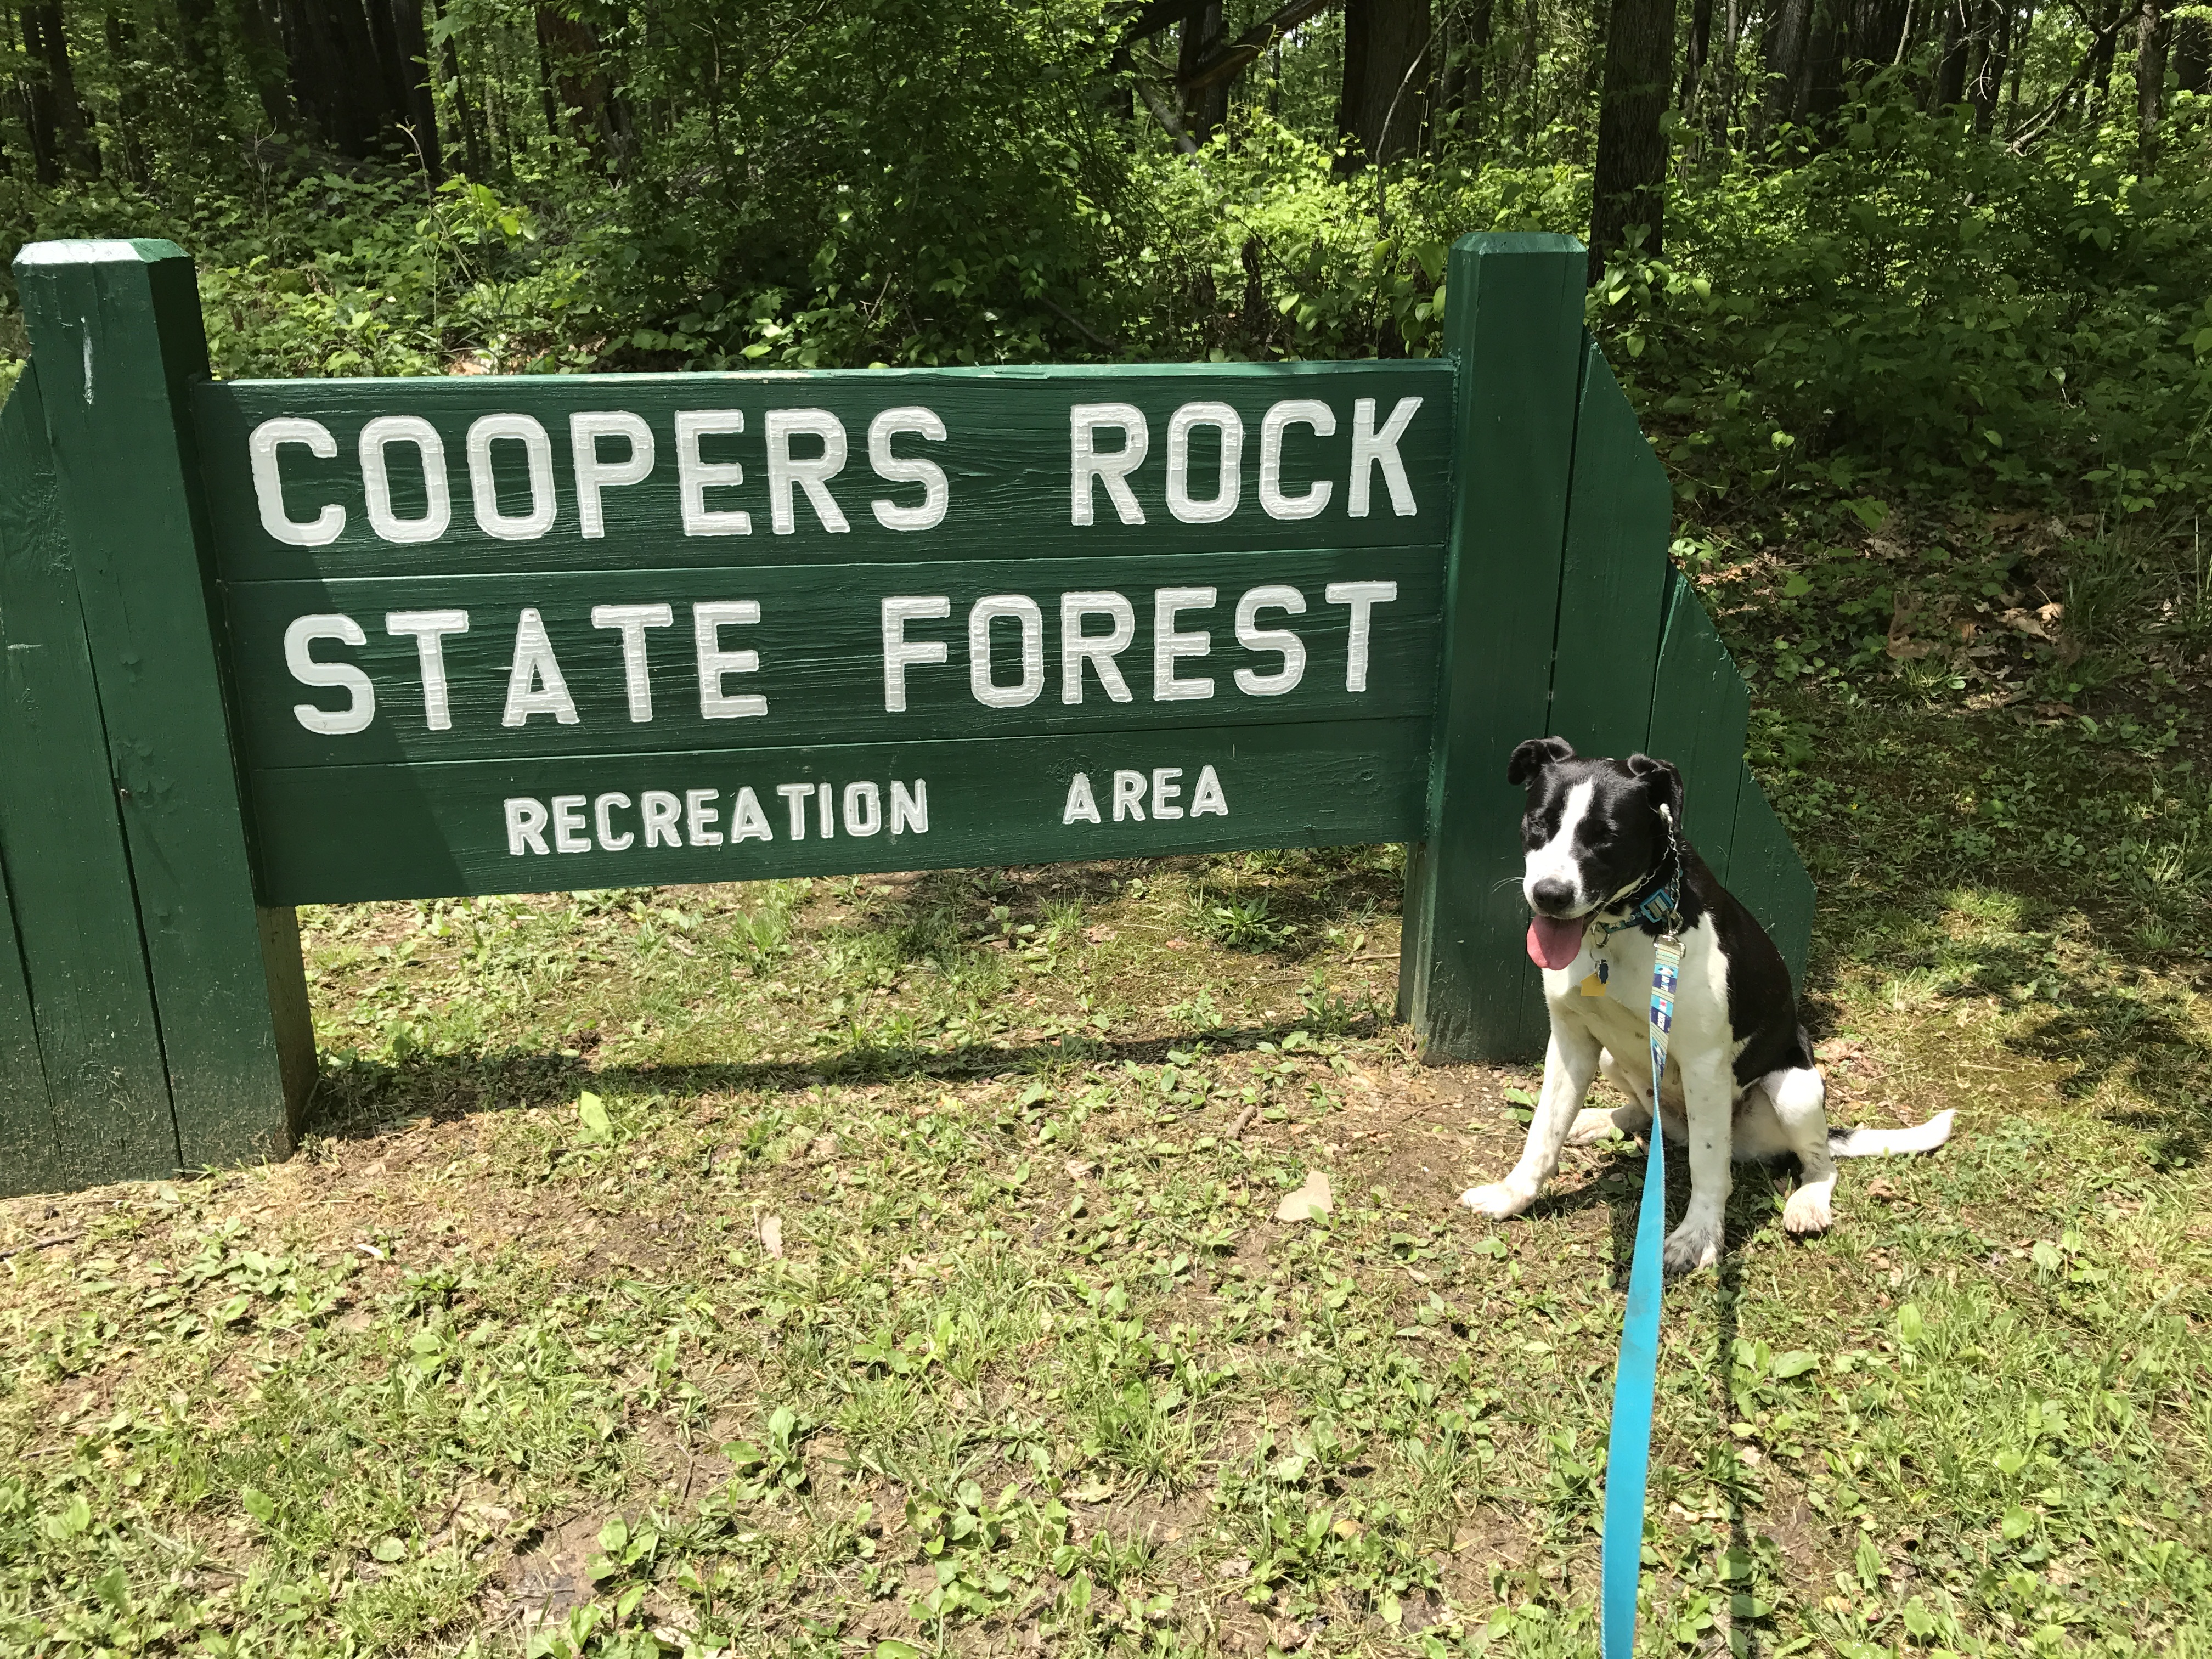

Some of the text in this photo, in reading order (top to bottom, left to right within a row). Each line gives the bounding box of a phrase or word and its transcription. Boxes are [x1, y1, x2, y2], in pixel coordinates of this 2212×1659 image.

[249, 396, 1424, 547] COOPERS ROCK
[284, 580, 1397, 735] STATE FOREST
[503, 764, 1229, 856] RECREATION AREA
